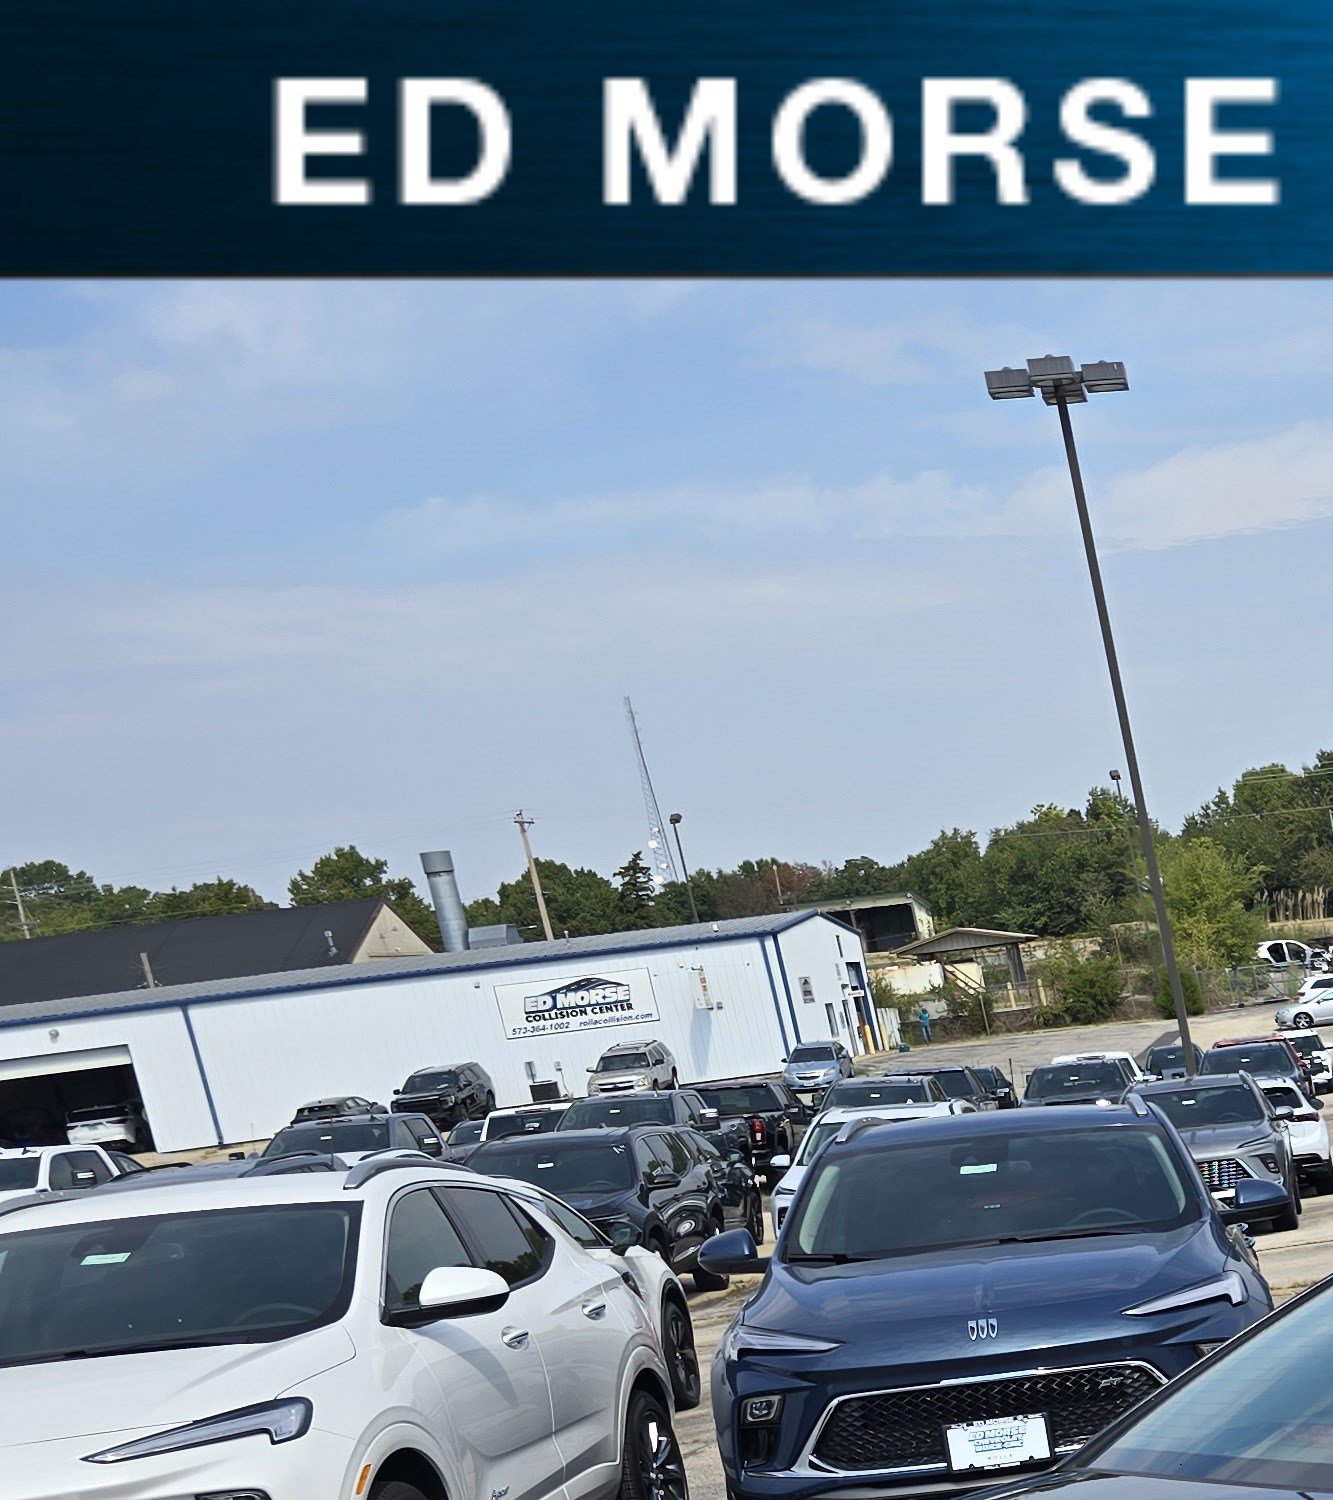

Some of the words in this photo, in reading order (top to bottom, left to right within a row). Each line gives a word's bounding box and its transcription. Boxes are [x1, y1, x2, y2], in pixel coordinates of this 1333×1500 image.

[524, 995, 553, 1012] ED
[556, 984, 630, 1009] MORSE
[526, 1007, 588, 1023] COLLISION
[591, 1003, 634, 1015] CENTER
[512, 1022, 570, 1035] 573-364-1002
